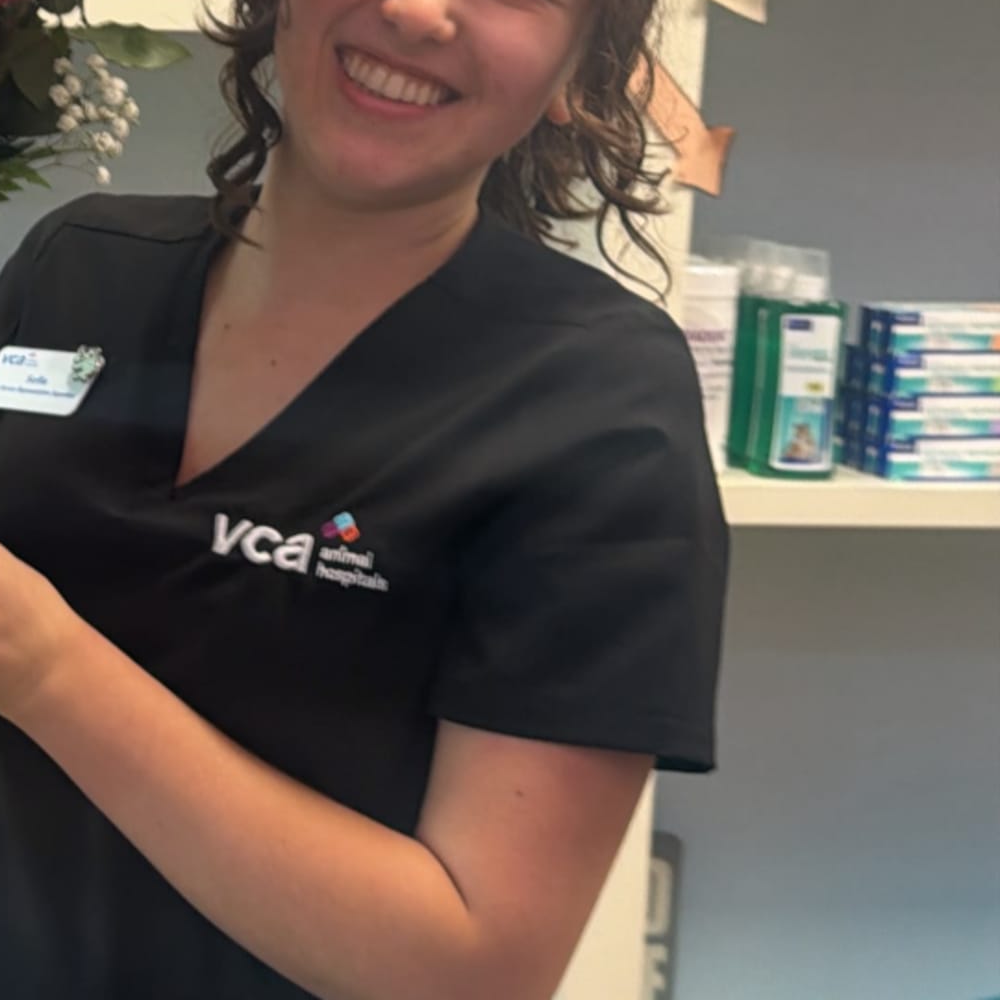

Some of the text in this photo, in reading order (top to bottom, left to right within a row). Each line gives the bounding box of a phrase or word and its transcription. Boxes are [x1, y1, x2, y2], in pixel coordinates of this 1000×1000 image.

[211, 512, 315, 575] vca
[318, 545, 374, 570] animal
[315, 560, 390, 592] hospitals
